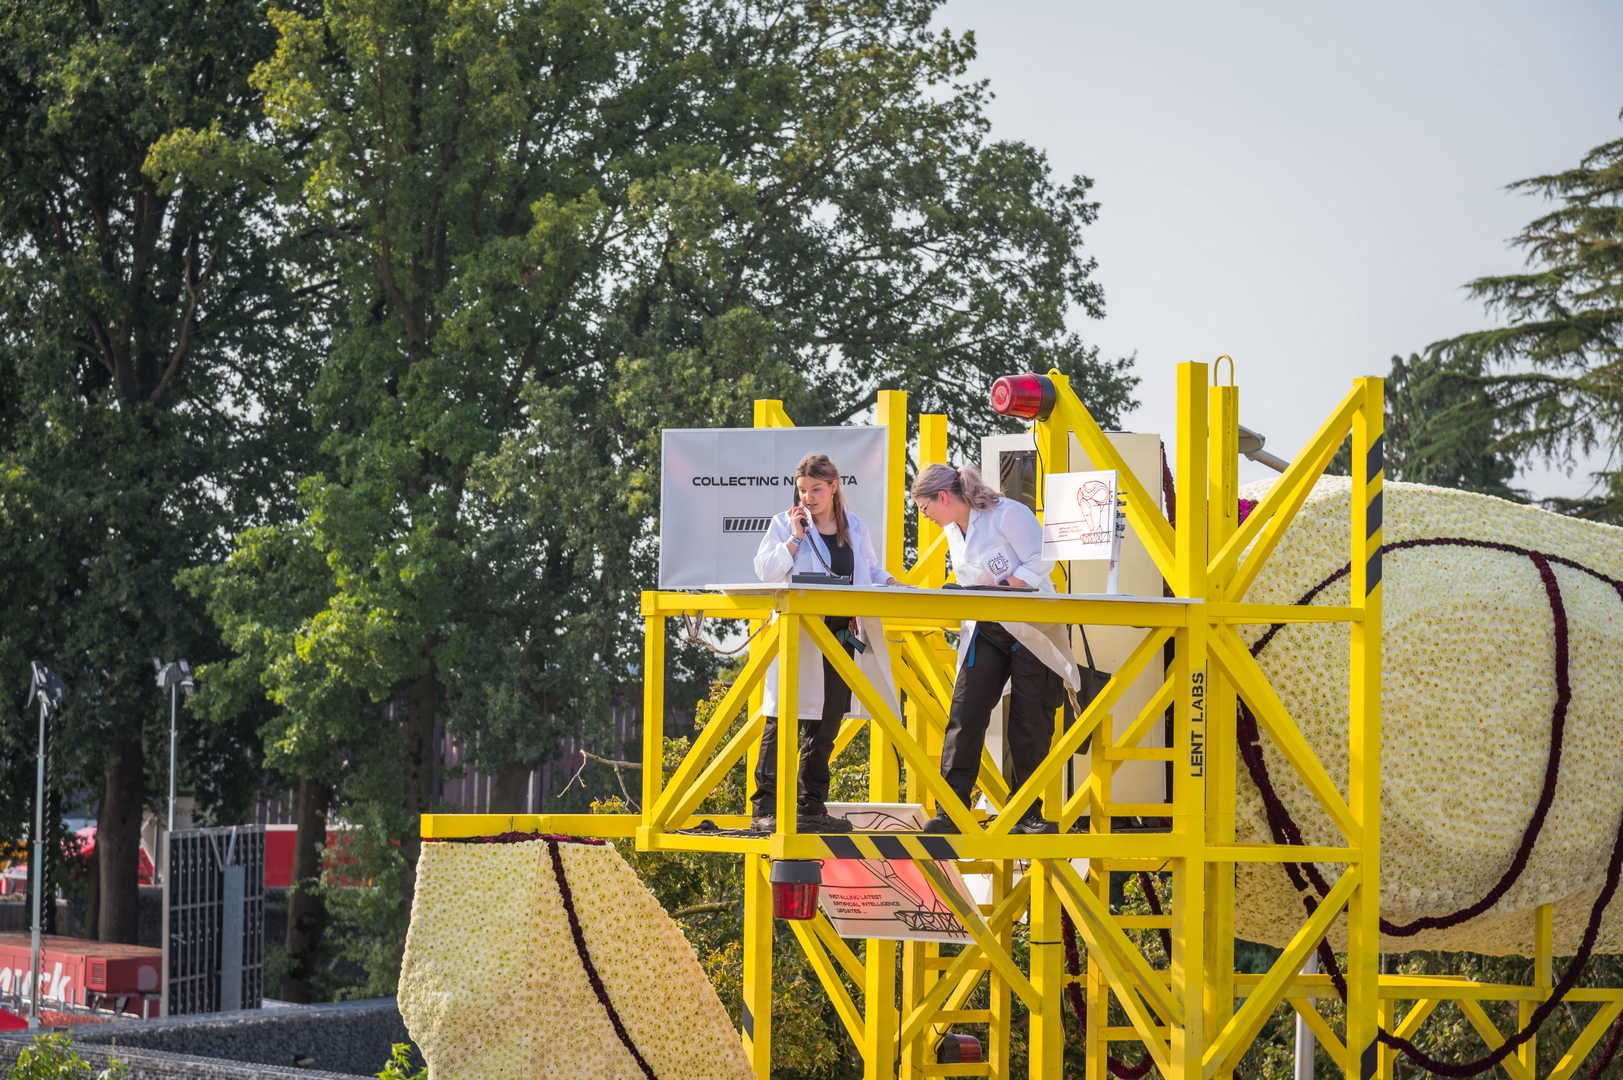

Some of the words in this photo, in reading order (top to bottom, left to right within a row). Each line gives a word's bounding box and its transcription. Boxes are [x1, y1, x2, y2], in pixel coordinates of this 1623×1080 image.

[692, 475, 779, 487] COLLECTING
[1191, 672, 1204, 722] LABS
[1190, 730, 1203, 777] LENT
